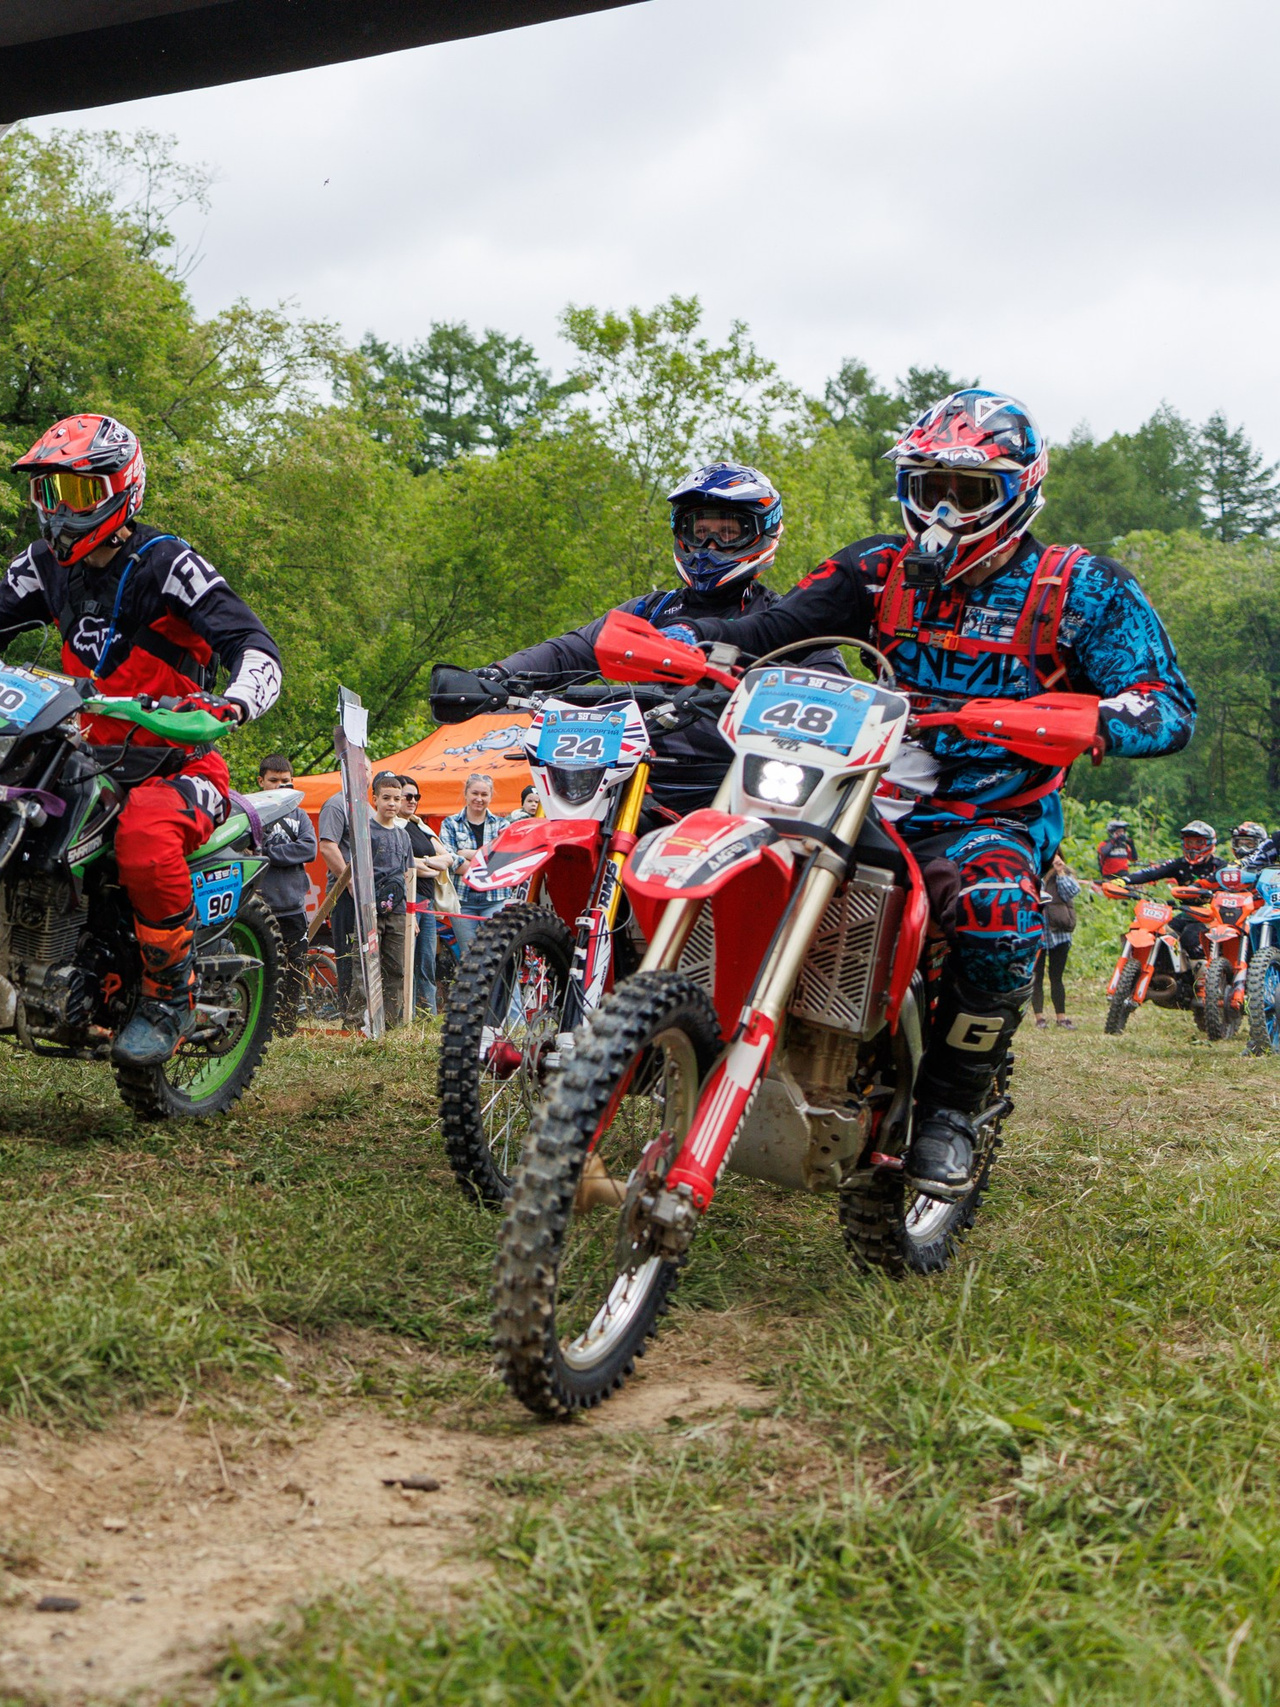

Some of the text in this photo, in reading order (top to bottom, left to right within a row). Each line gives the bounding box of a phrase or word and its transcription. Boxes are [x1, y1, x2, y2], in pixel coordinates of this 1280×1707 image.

[807, 694, 860, 713] КОНСТАНТИН
[762, 701, 834, 734] 48
[547, 727, 620, 736] МОСКАТОВ ГЕОРГИЙ
[553, 736, 602, 758] 24
[599, 860, 618, 909] RMS
[208, 892, 234, 919] 90
[946, 1012, 1005, 1052] G
